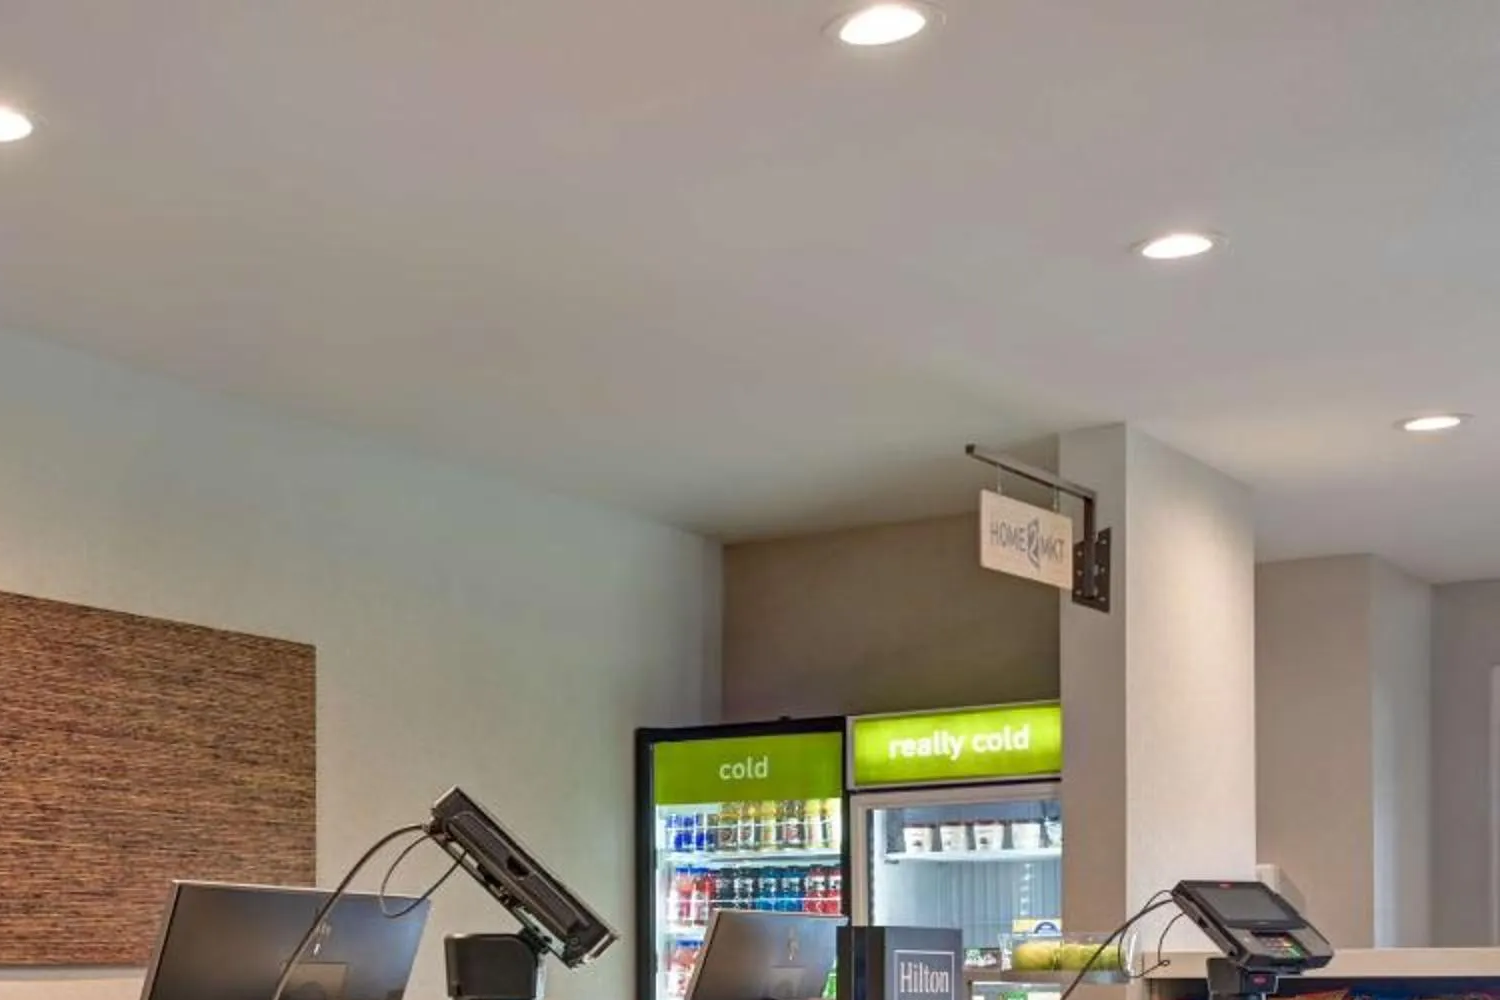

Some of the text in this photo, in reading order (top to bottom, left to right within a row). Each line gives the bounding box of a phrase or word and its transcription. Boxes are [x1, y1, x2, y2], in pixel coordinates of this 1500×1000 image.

[888, 725, 1031, 761] really cold
[718, 755, 769, 781] cold
[899, 961, 950, 993] Hilton
